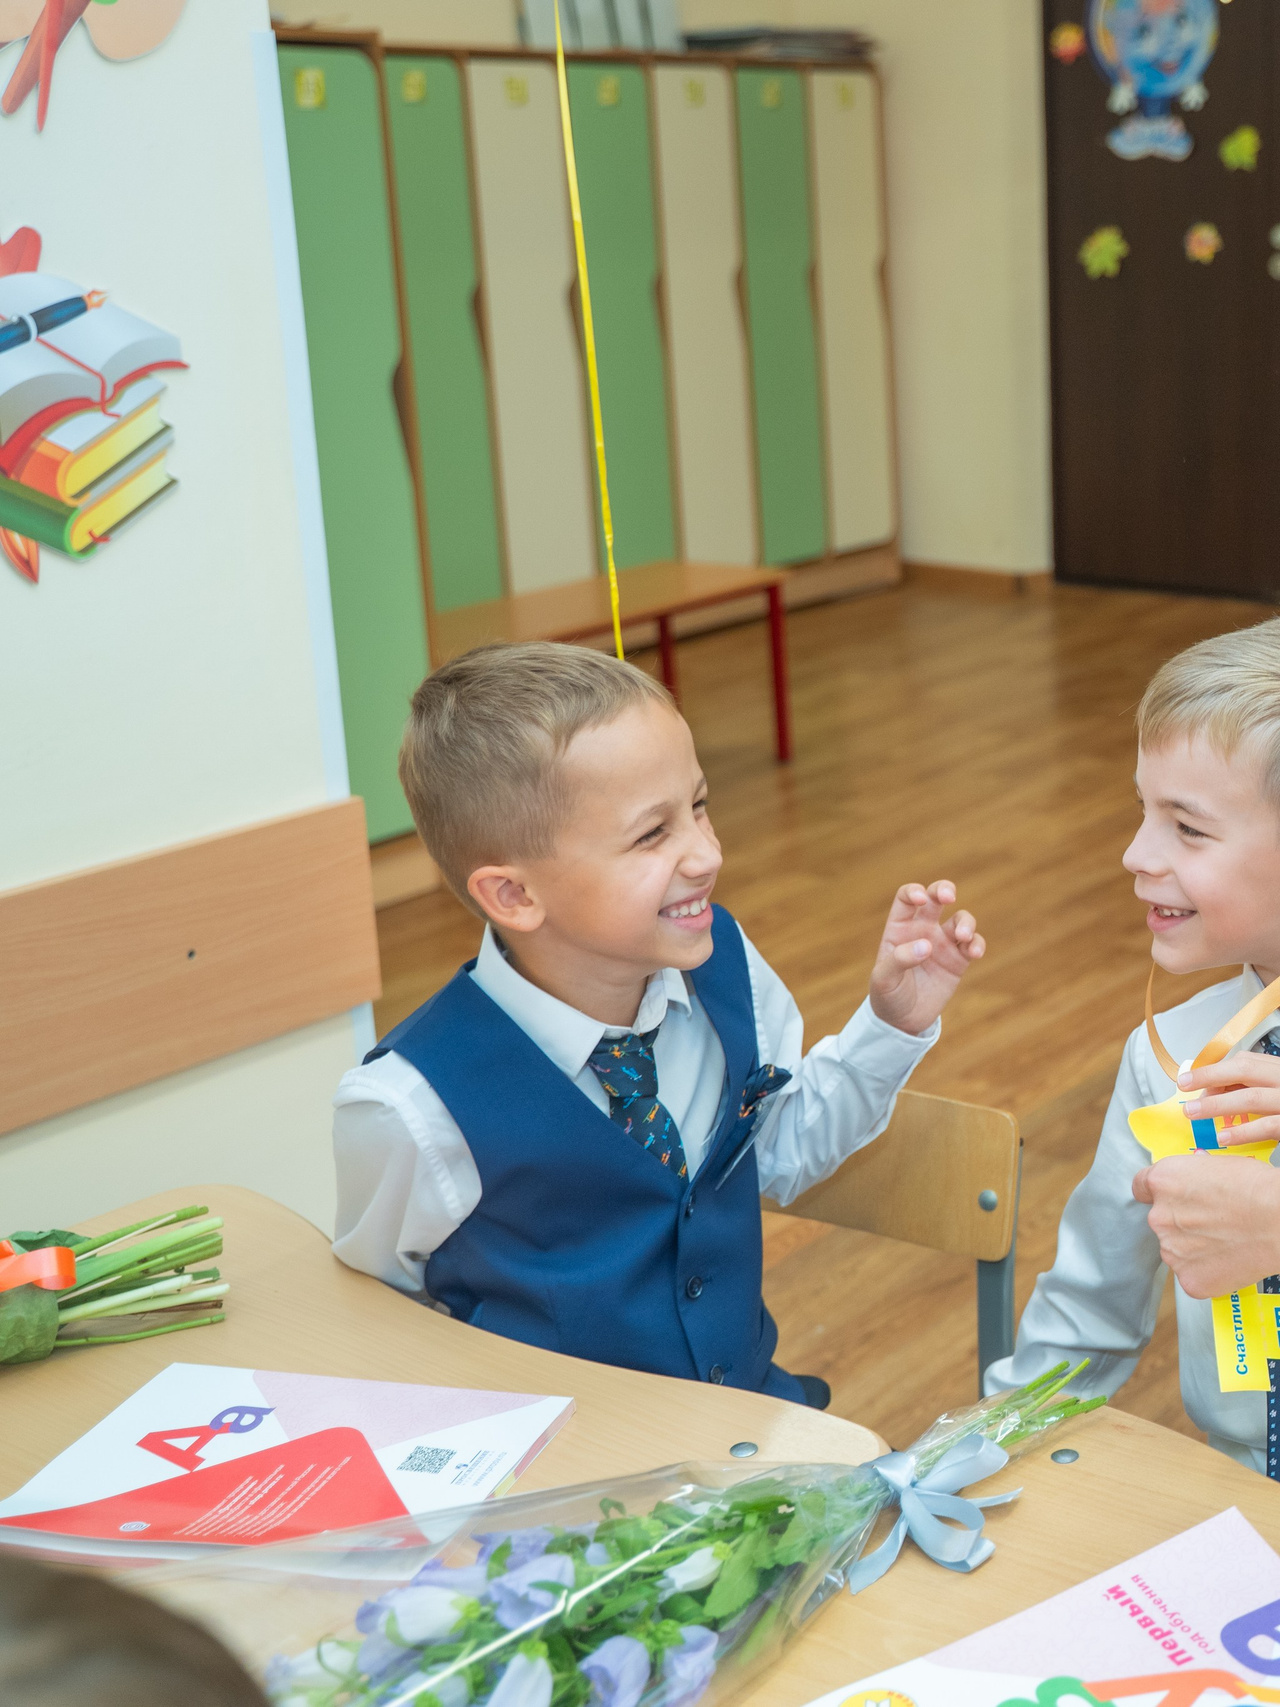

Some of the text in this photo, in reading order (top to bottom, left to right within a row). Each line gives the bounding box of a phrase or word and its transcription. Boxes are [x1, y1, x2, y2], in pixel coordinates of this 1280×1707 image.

[1230, 1290, 1248, 1375] Счастлив
[1102, 1584, 1195, 1666] Первый
[1131, 1574, 1215, 1654] год обучения
